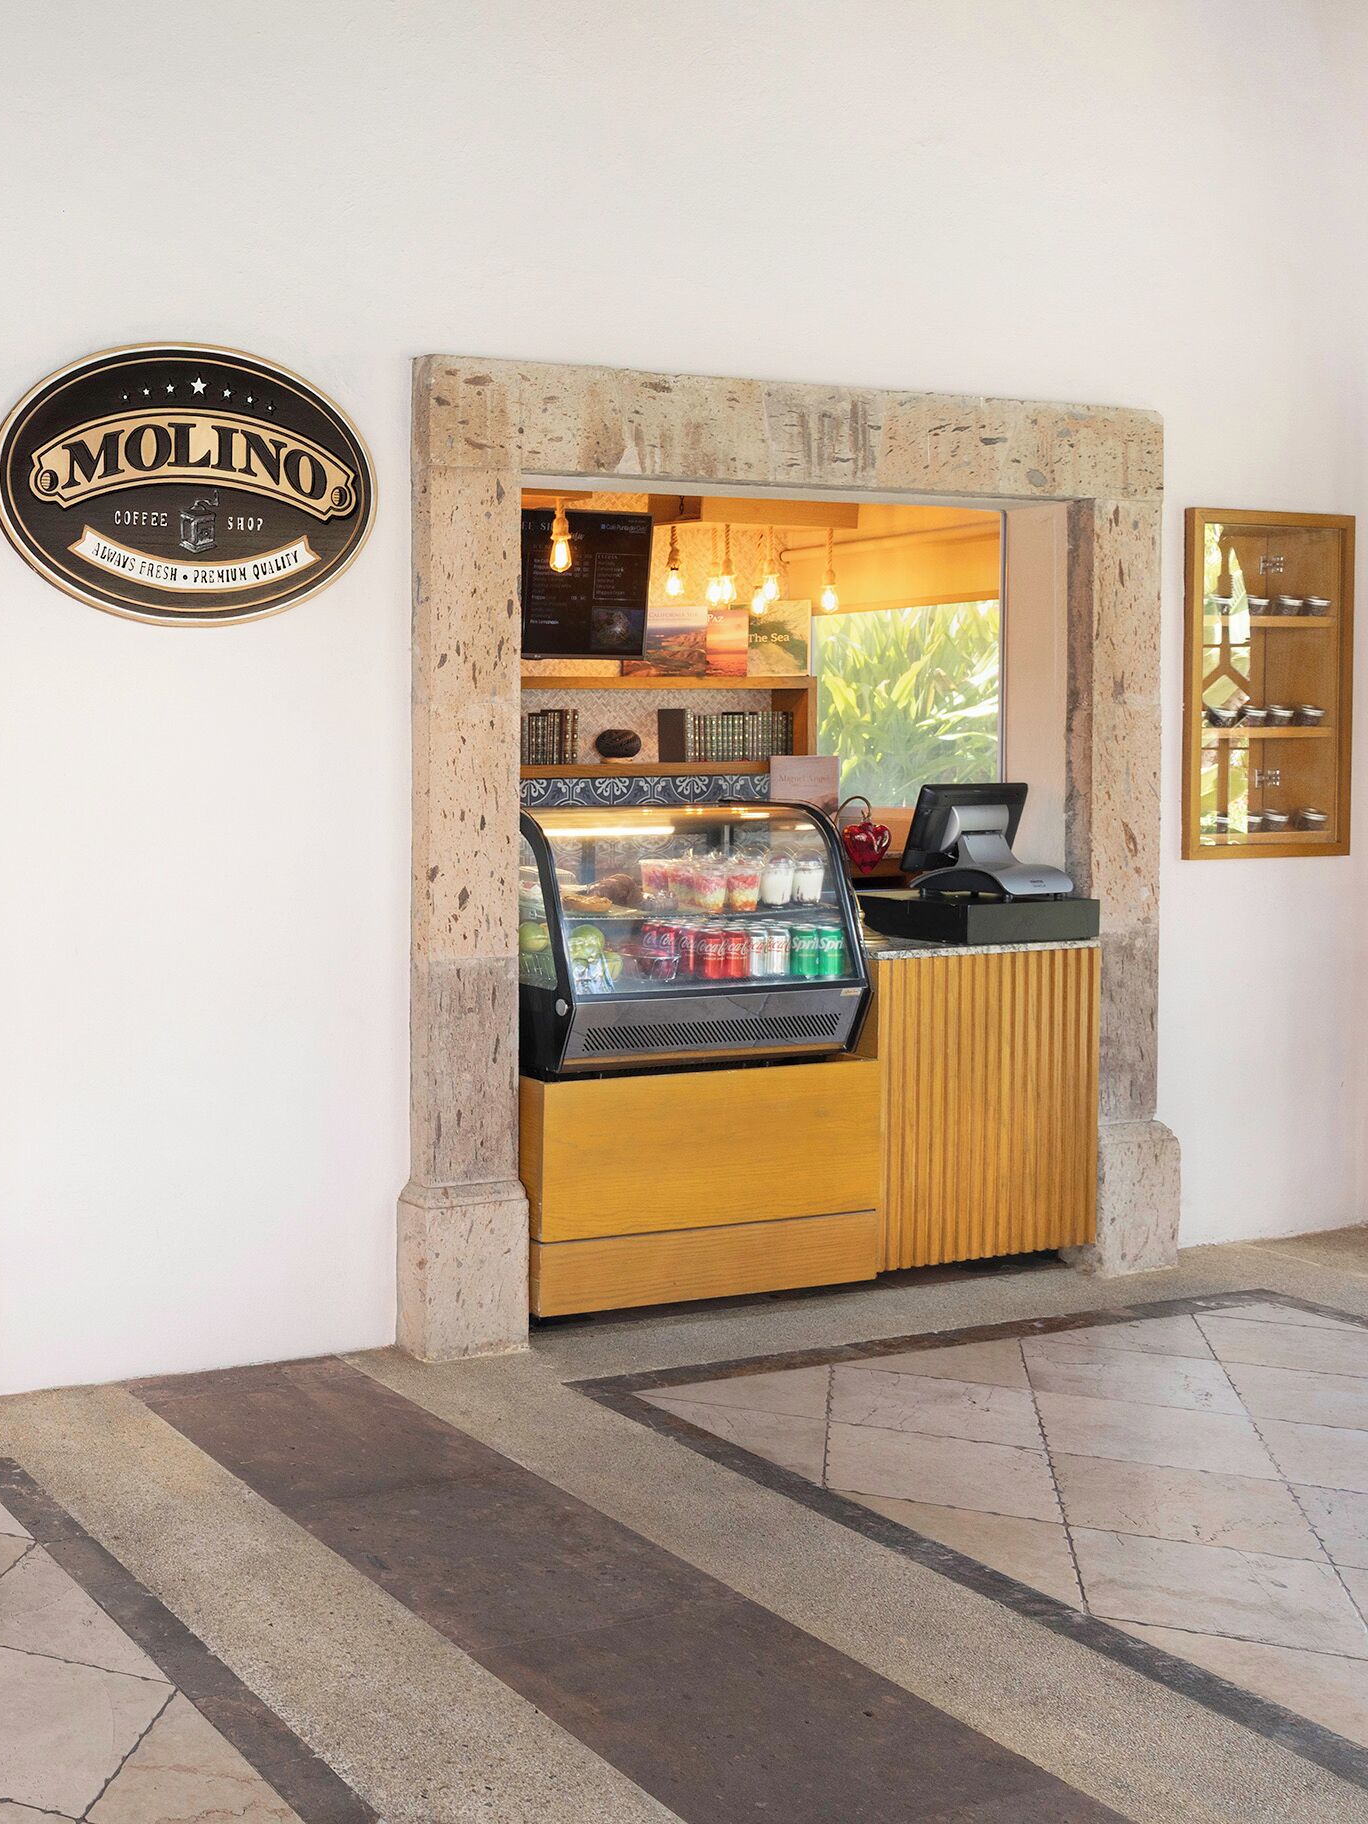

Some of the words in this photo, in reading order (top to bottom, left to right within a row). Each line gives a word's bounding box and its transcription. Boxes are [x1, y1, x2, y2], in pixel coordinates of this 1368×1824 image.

[60, 422, 328, 500] MOLINO
[114, 510, 168, 527] COFFEE
[227, 516, 264, 531] SHOP
[92, 543, 135, 571] ALWAYS
[139, 561, 177, 581] FRESH
[193, 567, 247, 584] PREMIUM
[253, 550, 298, 580] QUALITY
[749, 634, 767, 643] The
[770, 633, 790, 643] Sea
